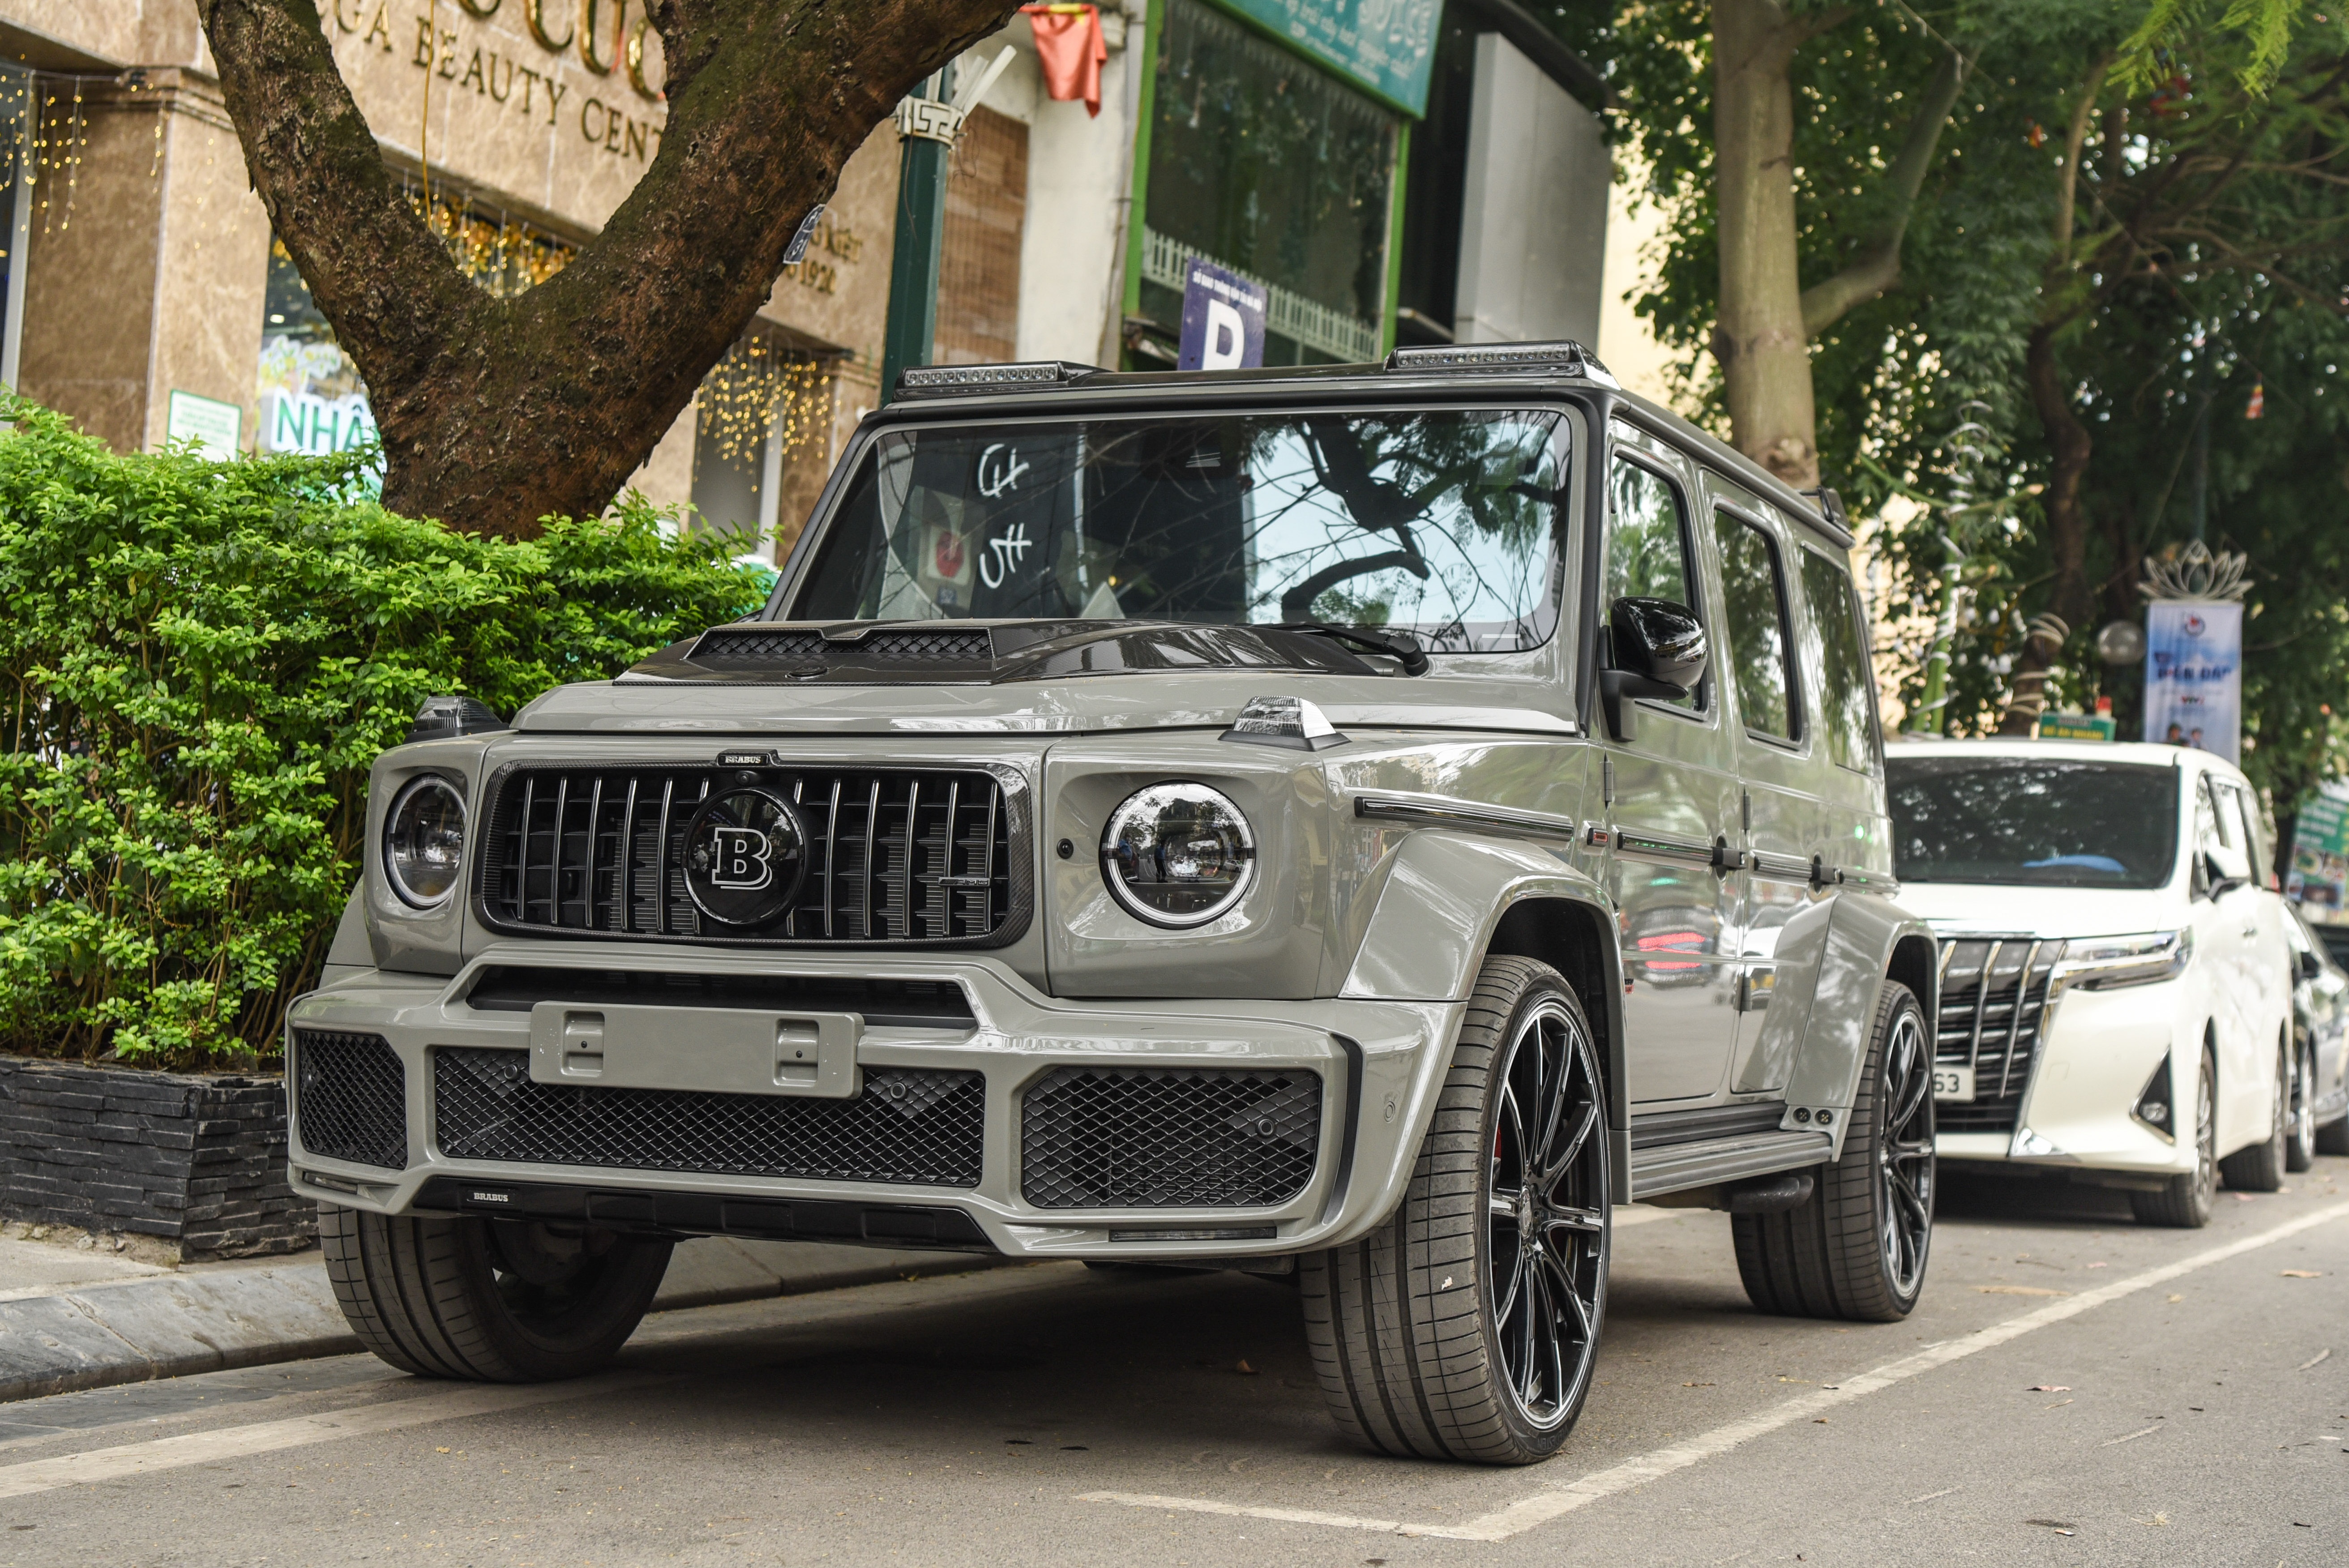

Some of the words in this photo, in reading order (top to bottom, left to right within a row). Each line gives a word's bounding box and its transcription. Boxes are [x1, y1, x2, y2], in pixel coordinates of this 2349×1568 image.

[319, 0, 392, 52] GA
[412, 15, 567, 126] BEAUTY
[712, 827, 772, 890] B
[474, 1192, 509, 1202] BRABUS
